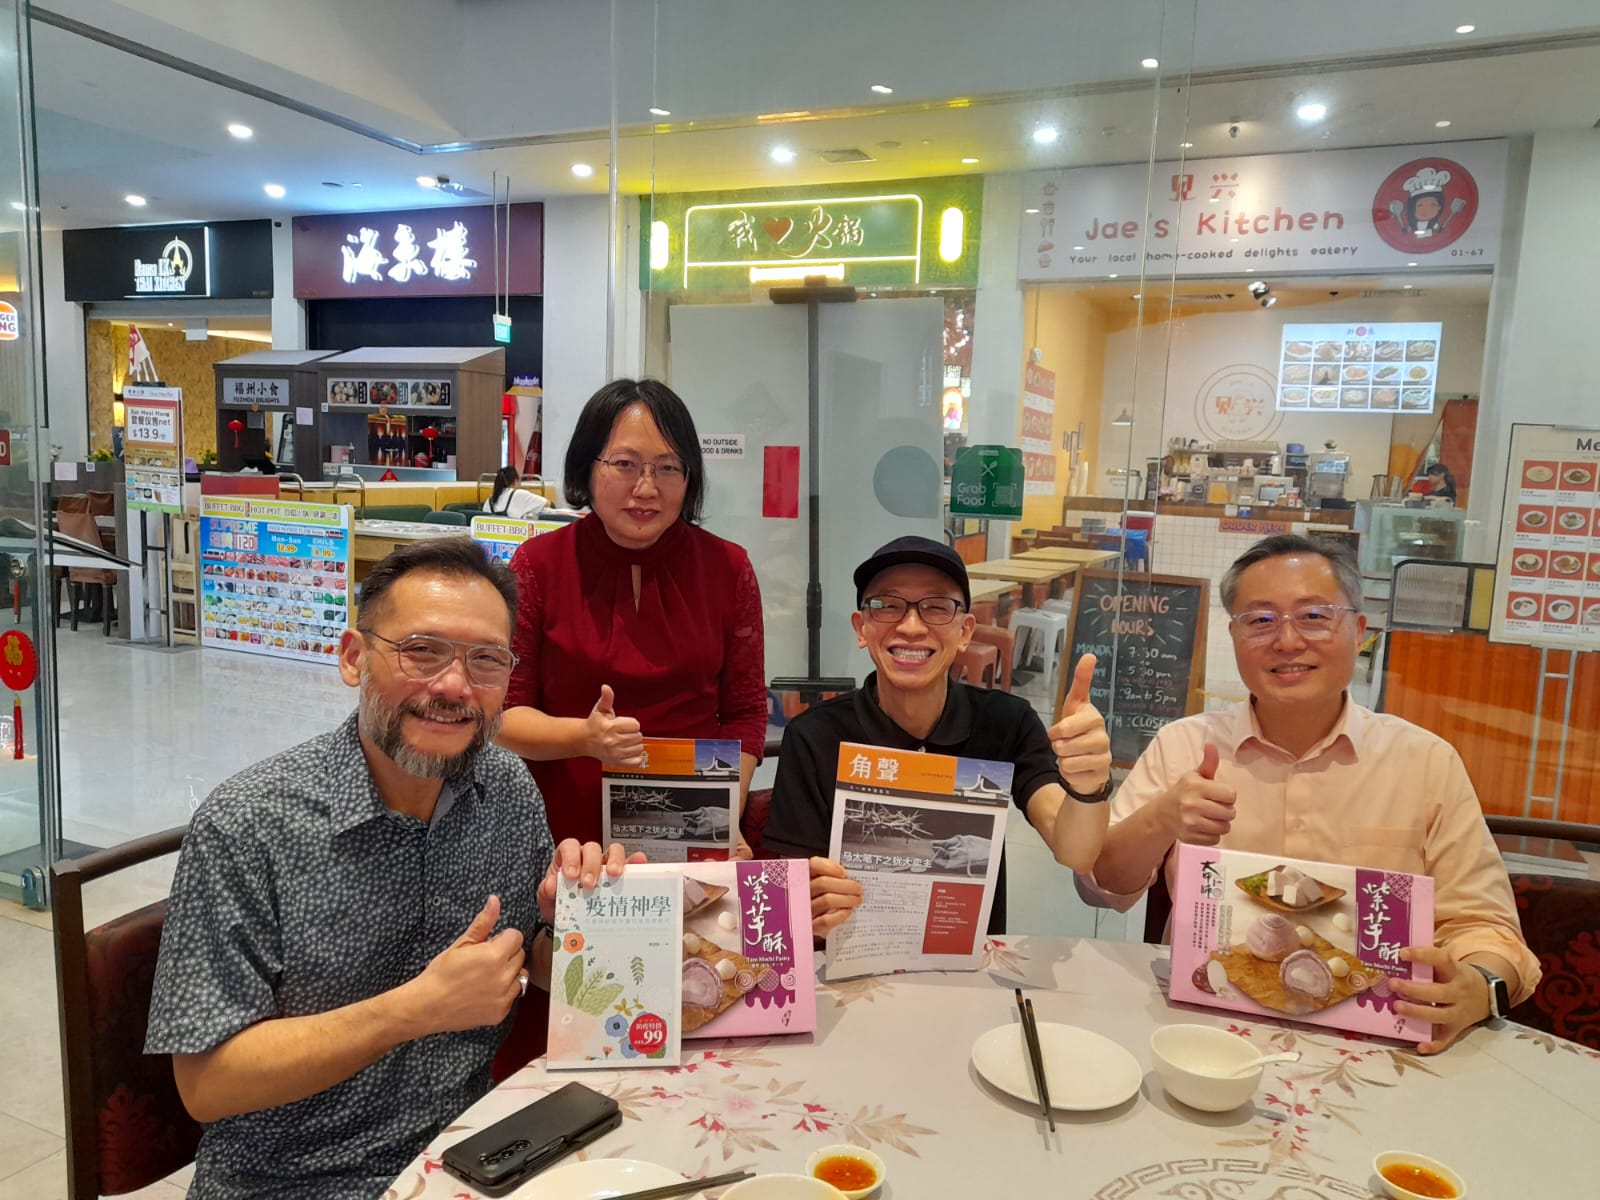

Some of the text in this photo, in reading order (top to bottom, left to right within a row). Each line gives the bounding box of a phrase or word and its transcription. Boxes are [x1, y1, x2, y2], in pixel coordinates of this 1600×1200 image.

[1085, 206, 1345, 241] Jae's Kitchen
[1069, 255, 1097, 264] Your
[1108, 252, 1136, 263] local
[1244, 247, 1299, 259] delights
[1310, 246, 1359, 256] eatery
[235, 381, 279, 396] 福州小食
[957, 482, 987, 494] Grab
[205, 503, 228, 512] BUFFET
[251, 506, 266, 514] HOT
[957, 494, 986, 506] Food
[476, 523, 507, 534] BUFFET
[508, 526, 528, 537] BBQ
[1100, 595, 1170, 614] OPENING
[1112, 617, 1155, 636] HOURS
[849, 752, 899, 783] 角聲
[586, 895, 671, 917] 疫情神學
[743, 872, 788, 955] 紫芋酥
[1361, 882, 1401, 965] 紫芋酥
[643, 1029, 663, 1045] 99
